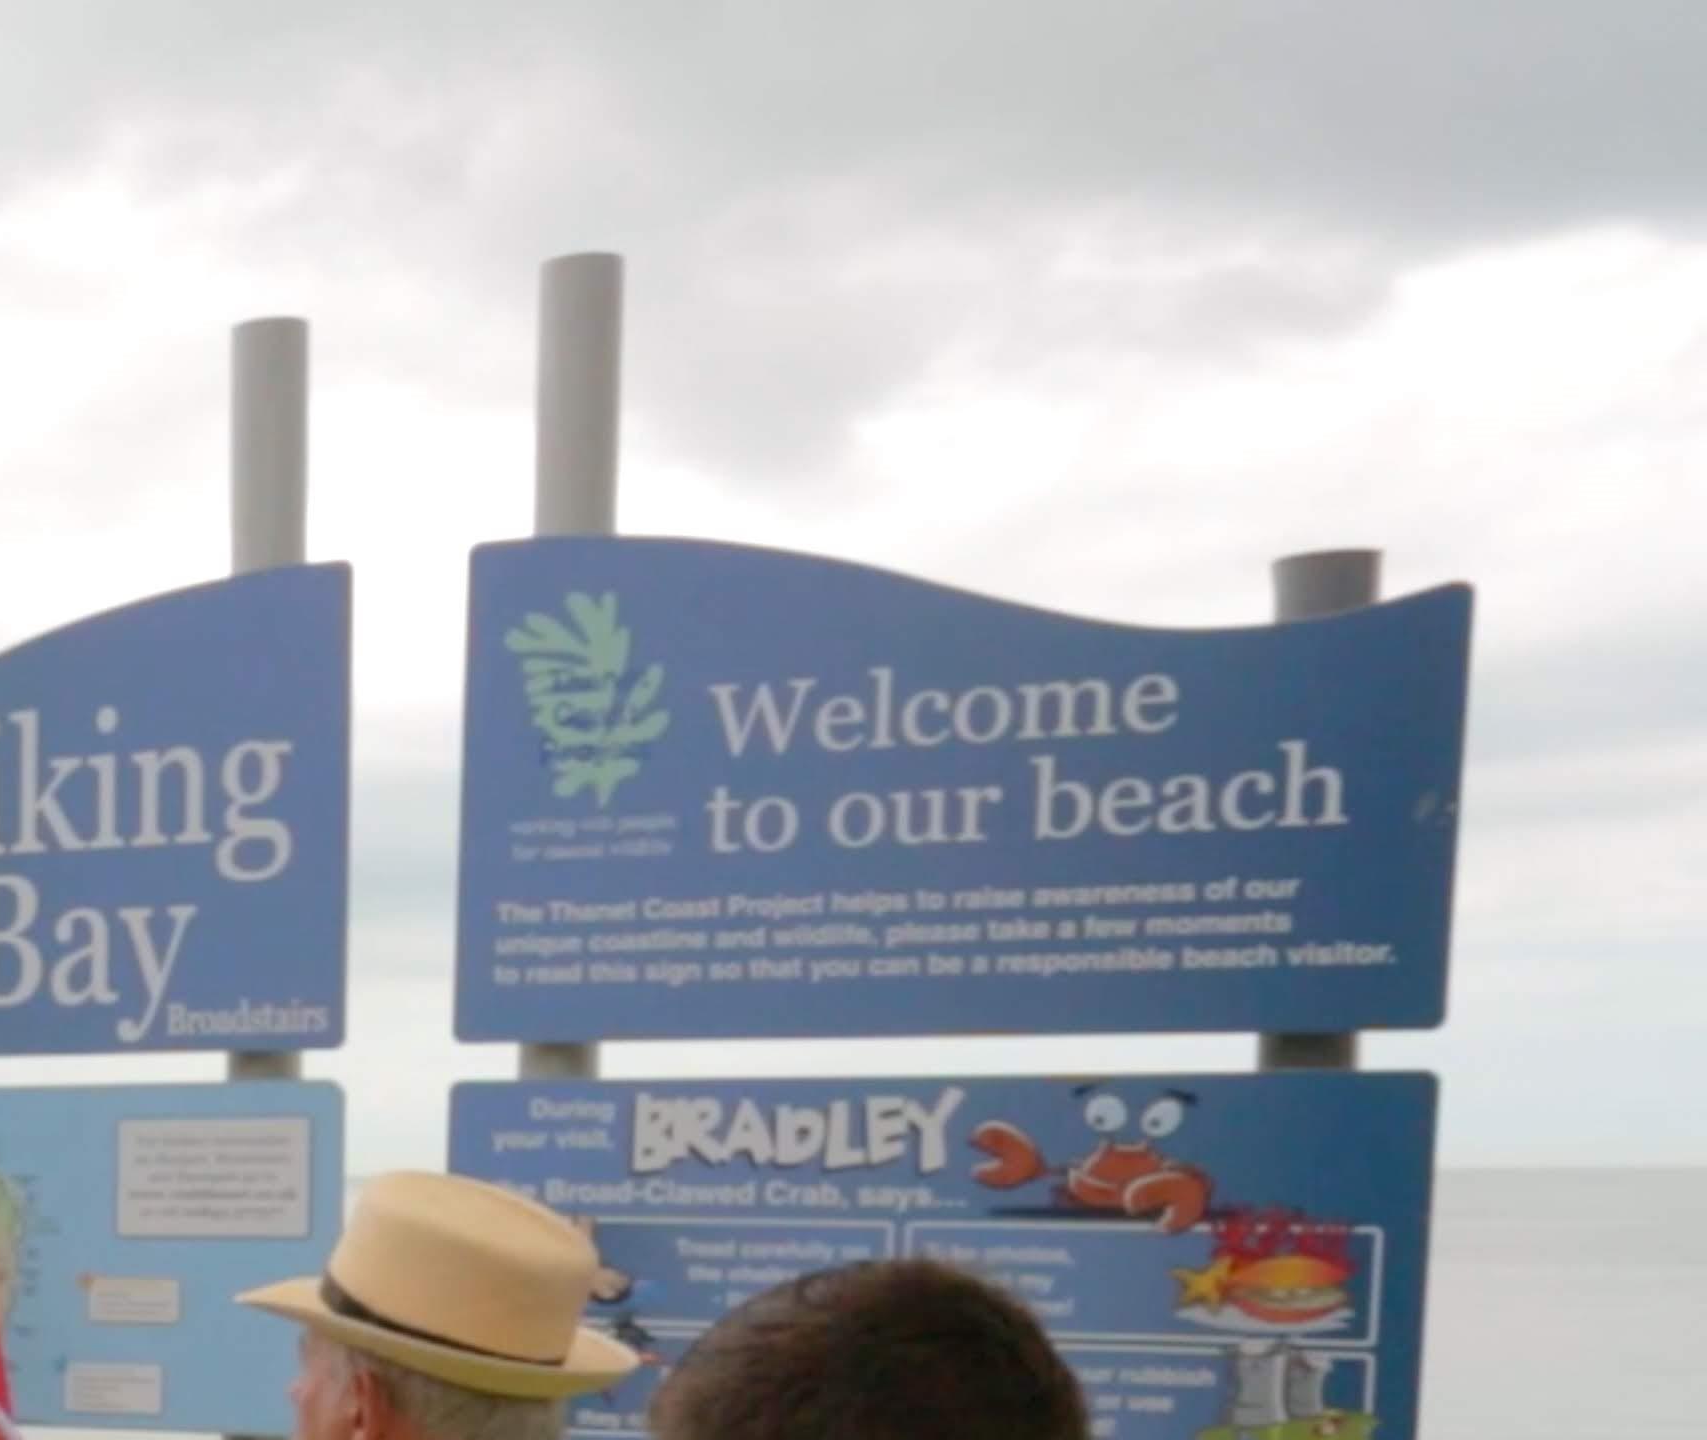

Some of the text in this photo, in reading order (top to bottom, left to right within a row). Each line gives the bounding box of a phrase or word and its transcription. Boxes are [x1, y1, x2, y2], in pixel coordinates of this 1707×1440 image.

[707, 666, 1180, 757] Welcome
[705, 739, 1351, 852] to our beach
[497, 875, 1302, 924] The Thanet Coast Project helps to raise awareness of our
[495, 934, 582, 957] unique
[589, 928, 707, 953] coastline
[715, 928, 766, 949] and
[885, 919, 980, 946] please
[988, 918, 1052, 941] take
[1058, 919, 1076, 938] a
[1085, 914, 1137, 937] few
[1146, 910, 1292, 935] moments
[494, 939, 1396, 987] to read this sign so that you can be a responsible beach visitor.
[165, 998, 329, 1037] Broadstairs
[529, 1097, 616, 1124] During
[632, 1086, 965, 1175] BRADLEY
[491, 1131, 546, 1154] your
[544, 1177, 757, 1207] Broad-Clawed
[763, 1180, 847, 1212] Crab,
